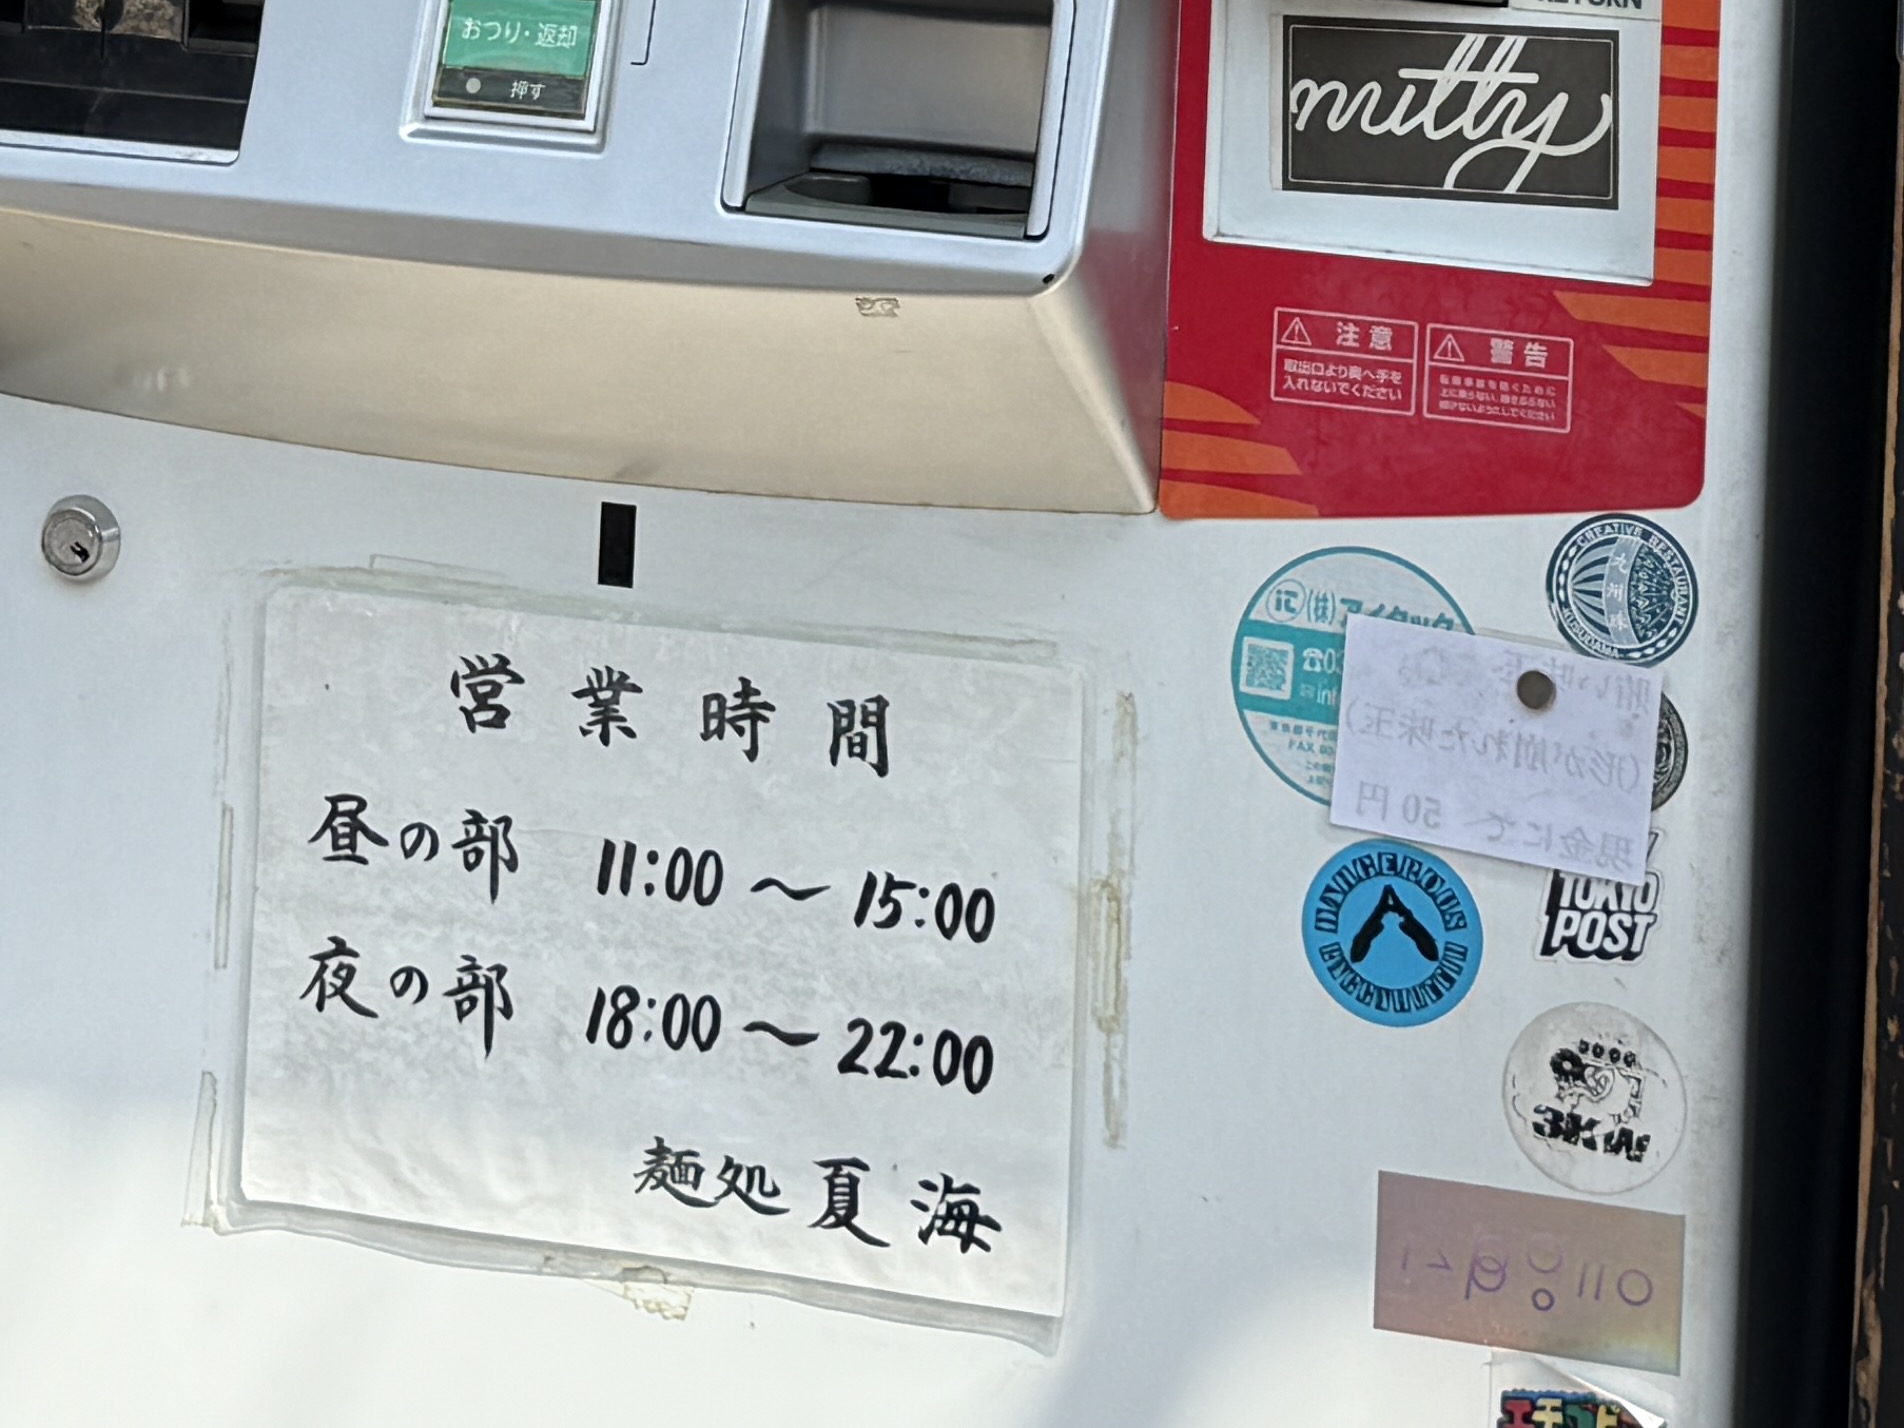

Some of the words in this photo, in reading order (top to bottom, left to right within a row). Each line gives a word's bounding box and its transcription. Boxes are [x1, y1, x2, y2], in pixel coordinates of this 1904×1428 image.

[462, 18, 576, 47] おつり・返却
[511, 80, 545, 99] 押す
[1336, 322, 1392, 350] 注意
[1490, 338, 1547, 368] 警告
[1284, 376, 1402, 401] 入れないでください
[449, 653, 891, 777] 営業時間
[307, 794, 520, 904] 昼の部
[1552, 911, 1658, 954] POST
[299, 936, 514, 1060] 夜の部
[633, 1136, 1002, 1255] 麺処夏海
